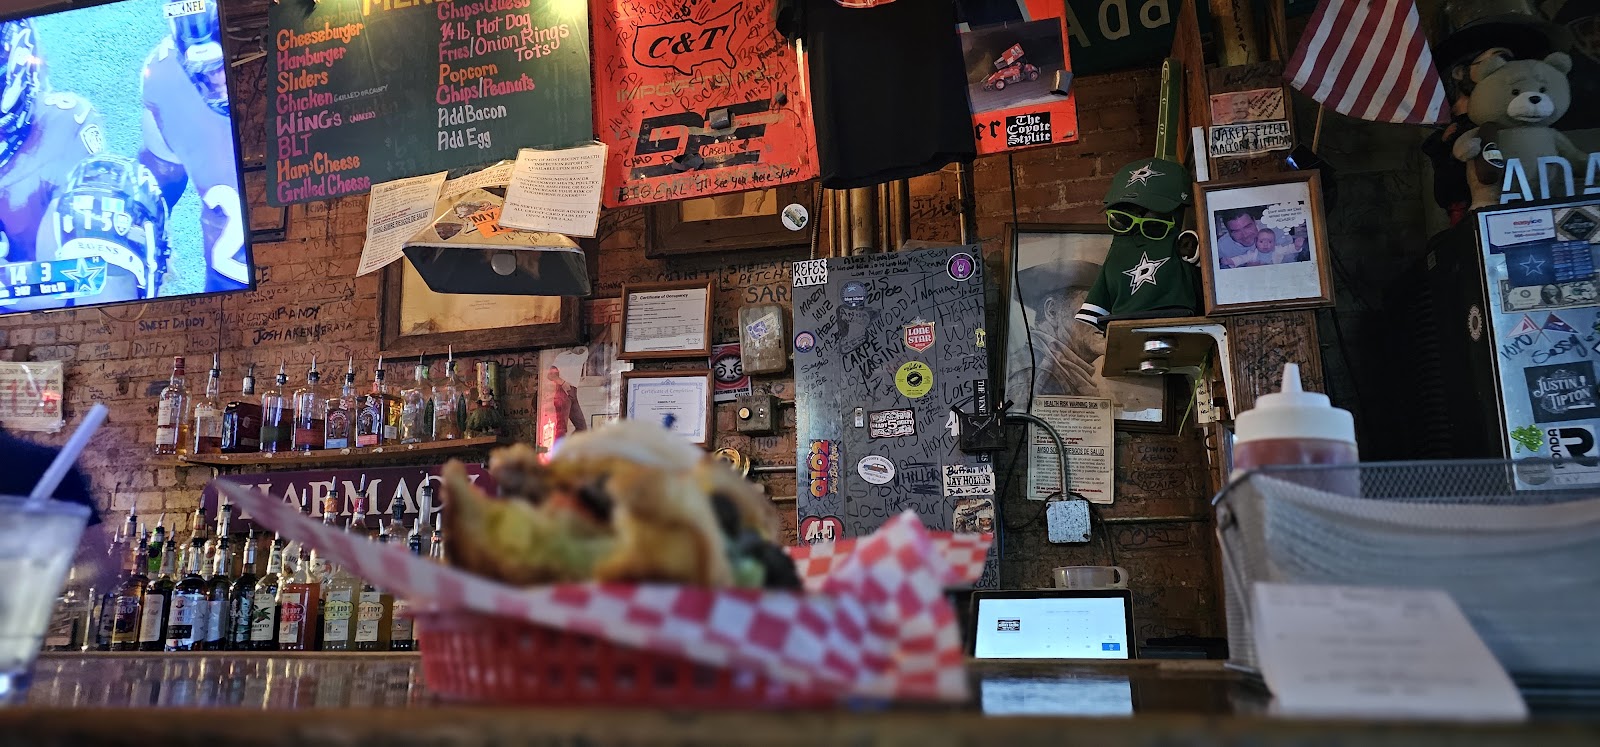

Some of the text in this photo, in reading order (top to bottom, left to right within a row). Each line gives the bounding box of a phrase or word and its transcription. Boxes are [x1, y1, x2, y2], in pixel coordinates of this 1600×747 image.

[186, 1, 204, 13] NFL
[437, 2, 480, 21] Chips
[476, 17, 503, 36] Hot
[505, 13, 531, 34] Dog
[276, 22, 364, 51] Cheeseburger
[520, 23, 570, 50] Rings
[649, 25, 730, 59] C&T
[276, 46, 347, 72] Hamburger
[513, 44, 551, 62] Tots
[276, 70, 329, 94] Sliders
[438, 63, 498, 86] Popcorn
[276, 90, 334, 115] Chicken
[438, 104, 507, 128] Add Bacon
[1015, 115, 1041, 126] The
[438, 127, 492, 151] Add Egg
[1006, 122, 1051, 135] Coyote
[1007, 132, 1051, 145] Stylite
[277, 133, 312, 160] BLT
[277, 174, 371, 203] Grilled Cheese
[618, 183, 651, 203] BIG
[9, 262, 52, 285] 14 3
[138, 319, 169, 332] SWEET
[252, 327, 283, 346] JOSH
[907, 326, 930, 336] LONE
[907, 334, 932, 344] STAR
[1533, 376, 1577, 397] JUSTIN
[1547, 388, 1591, 411] TIPTON
[1090, 449, 1104, 457] SALUD
[946, 475, 962, 487] JAY
[962, 475, 991, 487] HOLLIS
